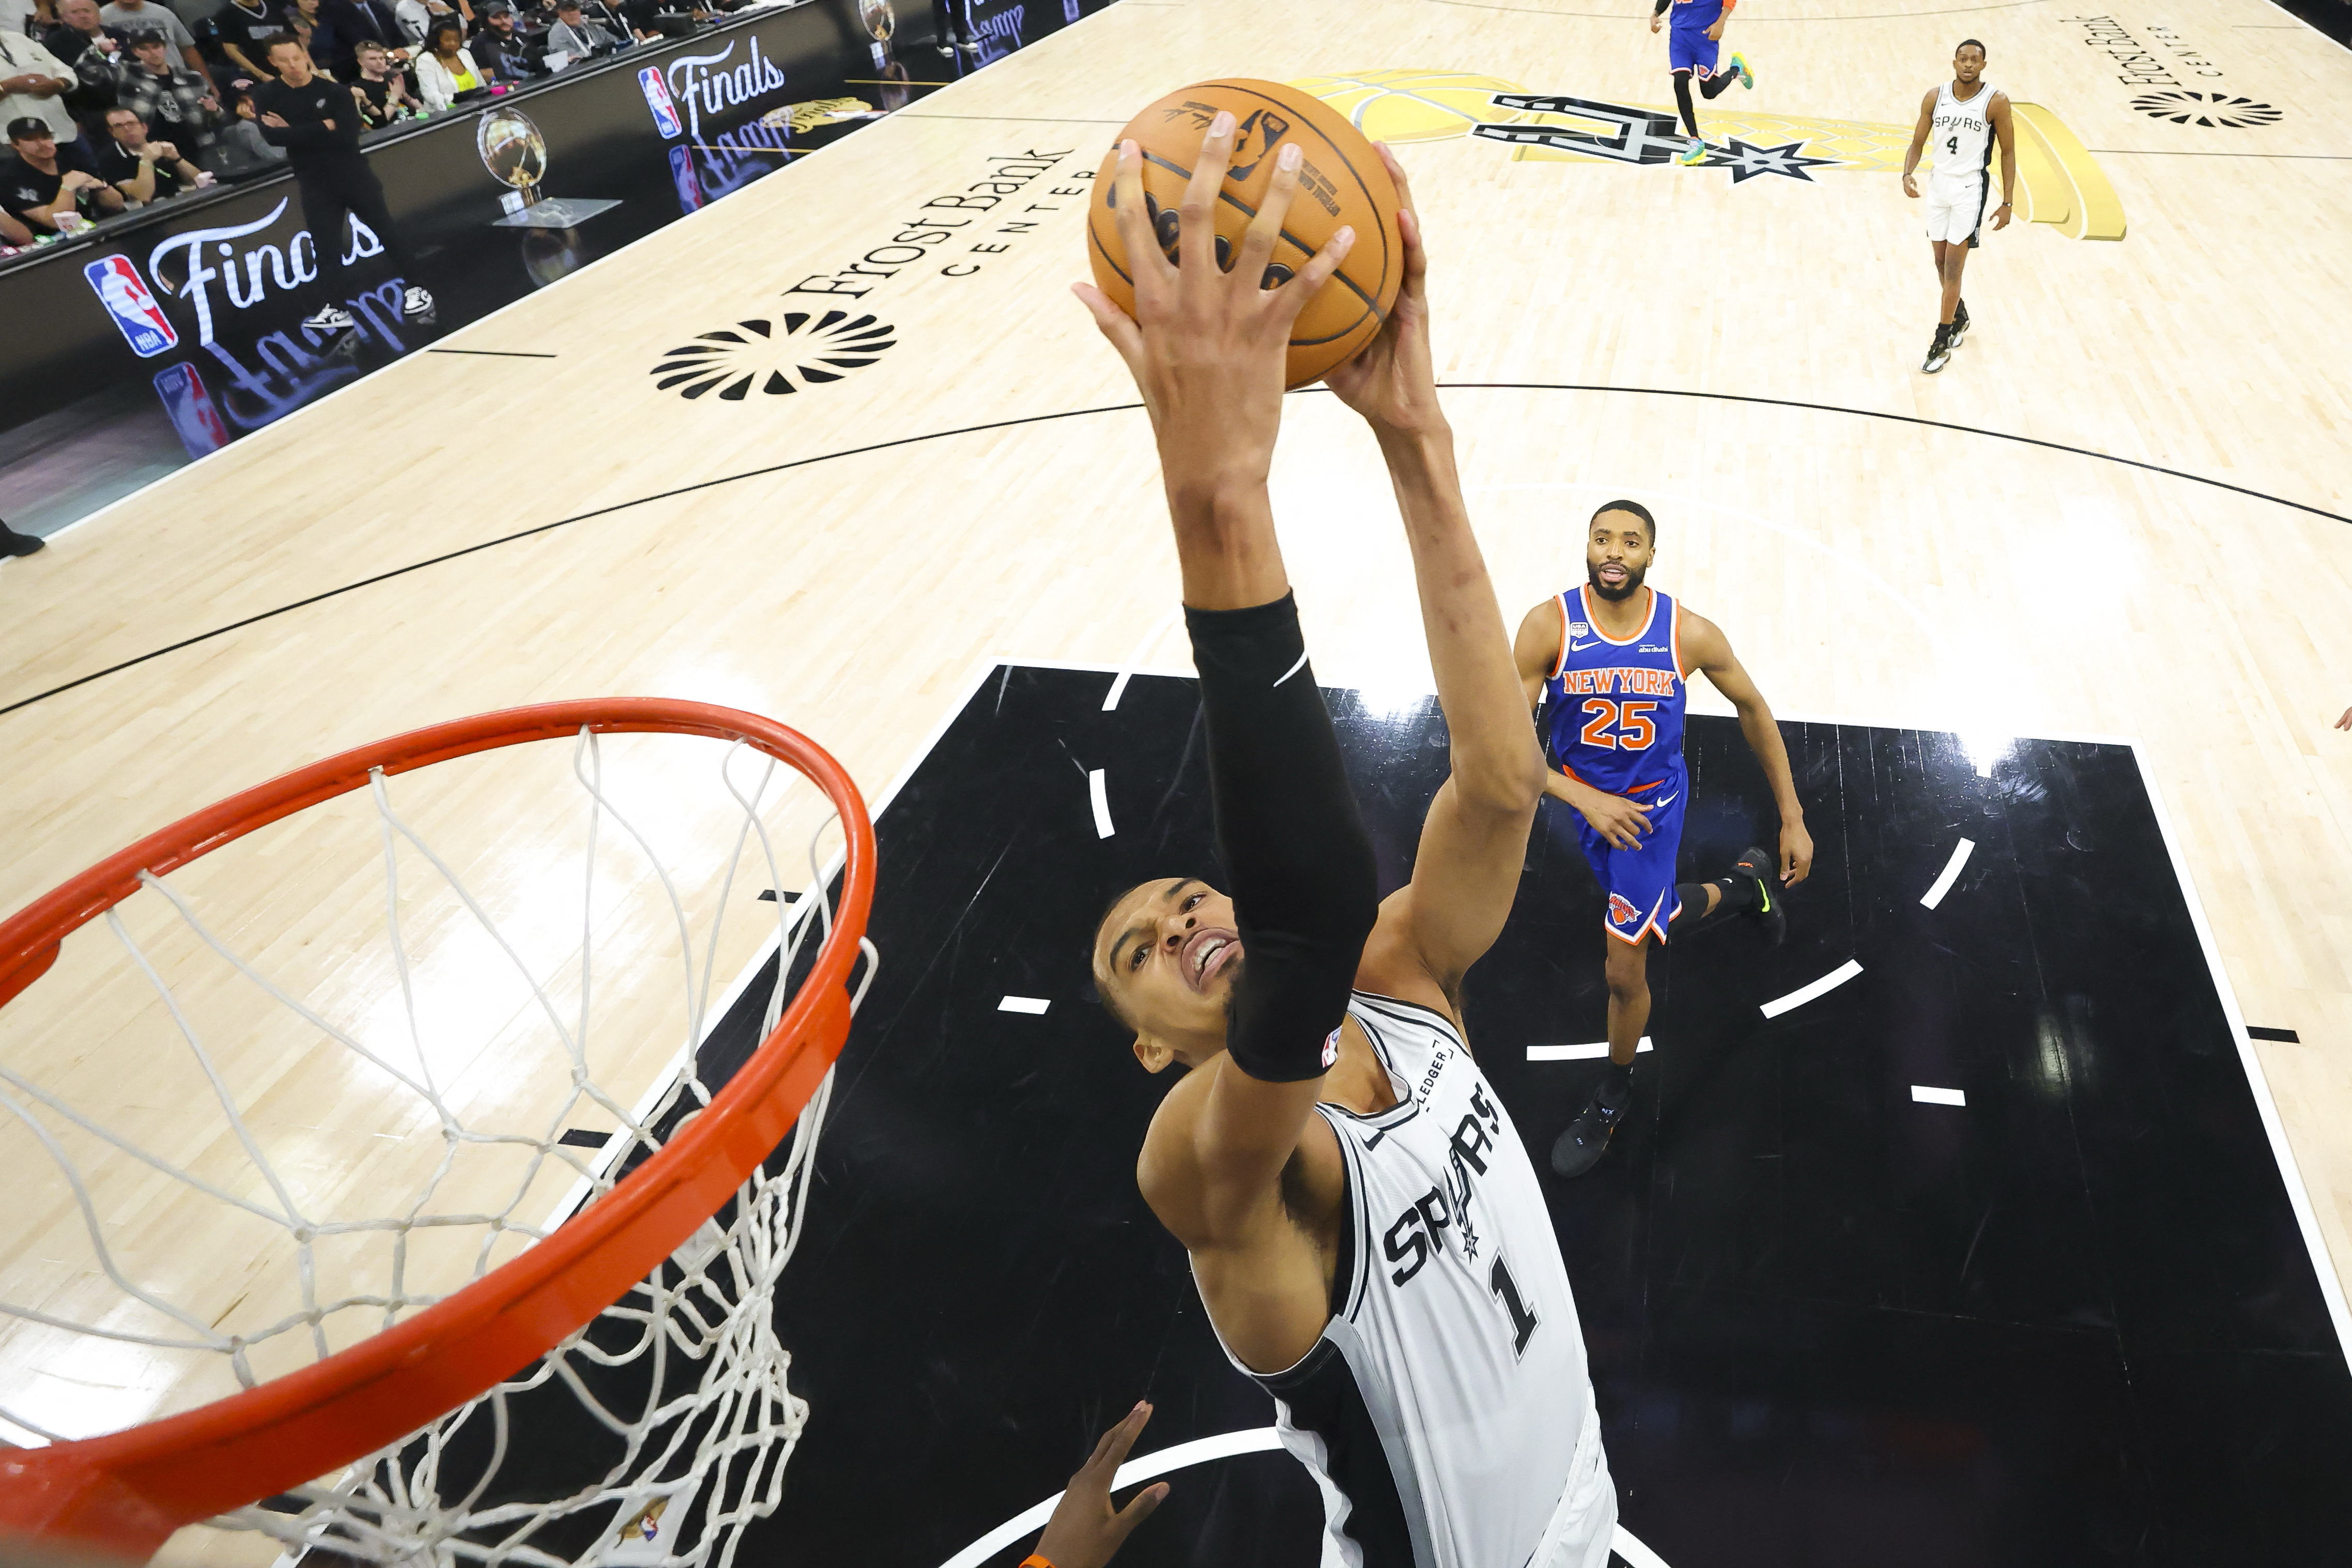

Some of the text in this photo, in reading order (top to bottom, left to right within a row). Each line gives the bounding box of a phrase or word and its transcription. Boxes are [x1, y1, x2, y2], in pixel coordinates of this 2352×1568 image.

[2147, 27, 2223, 76] CENTER
[667, 35, 785, 136] Finals
[1935, 116, 1982, 132] SPURS
[1947, 136, 1958, 155] 4
[941, 171, 1098, 277] CENTER
[149, 196, 385, 347] Finas
[135, 330, 162, 351] NBA
[1563, 667, 1677, 697] NEW YORK
[1580, 698, 1658, 750] 25
[1416, 1052, 1447, 1104] LEDGER
[1383, 1082, 1500, 1287] SPURS
[1488, 1246, 1542, 1365] 1
